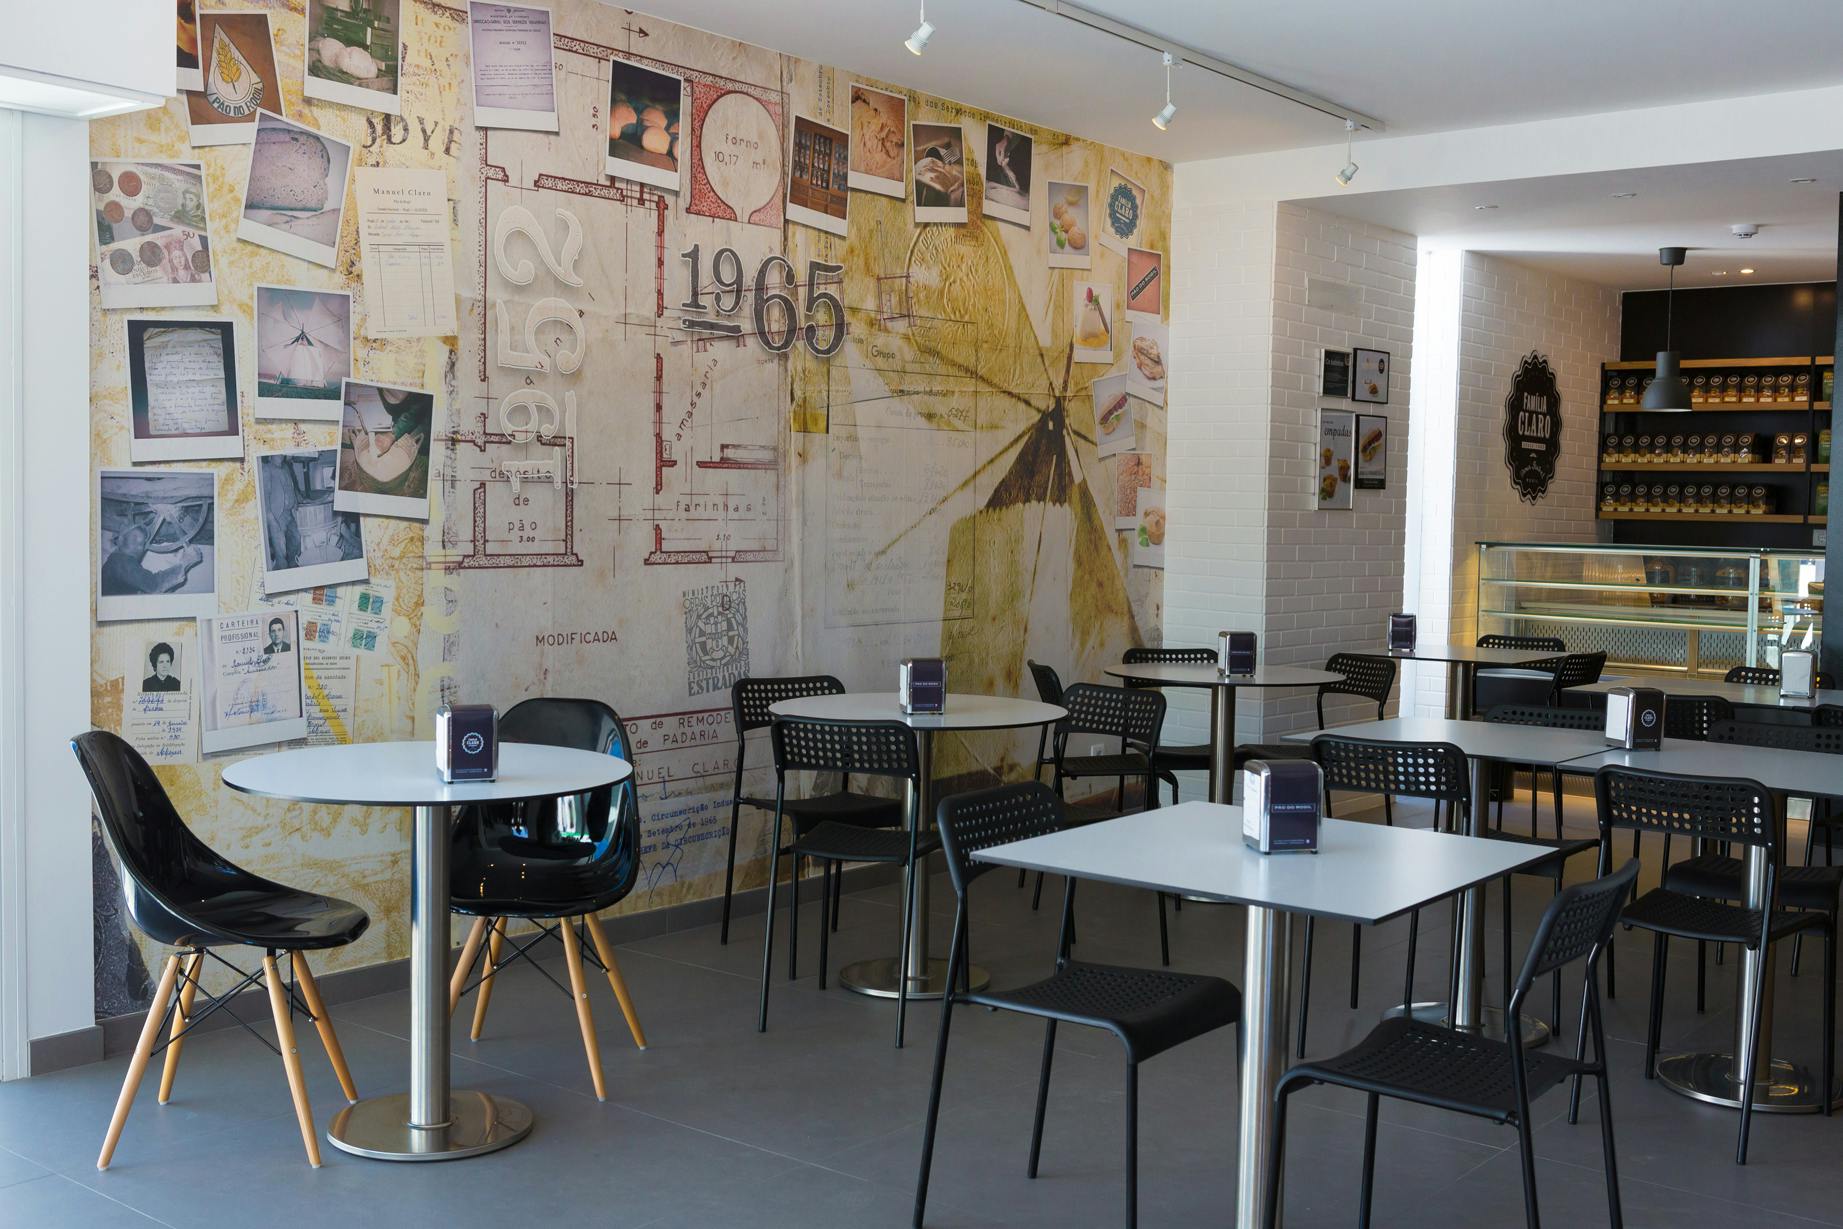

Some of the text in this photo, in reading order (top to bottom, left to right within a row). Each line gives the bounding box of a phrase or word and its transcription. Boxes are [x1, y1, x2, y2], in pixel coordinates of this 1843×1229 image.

[724, 132, 760, 151] forno
[680, 242, 847, 358] 1965
[675, 357, 719, 442] amassaria
[1523, 391, 1548, 413] FAMÍLIA
[1518, 411, 1551, 440] CLARO
[512, 494, 530, 506] de
[676, 500, 752, 513] farinhas
[507, 519, 538, 533] pão
[535, 630, 619, 647] MODIFICADA
[650, 720, 664, 730] de
[636, 729, 719, 749] de PADARIA
